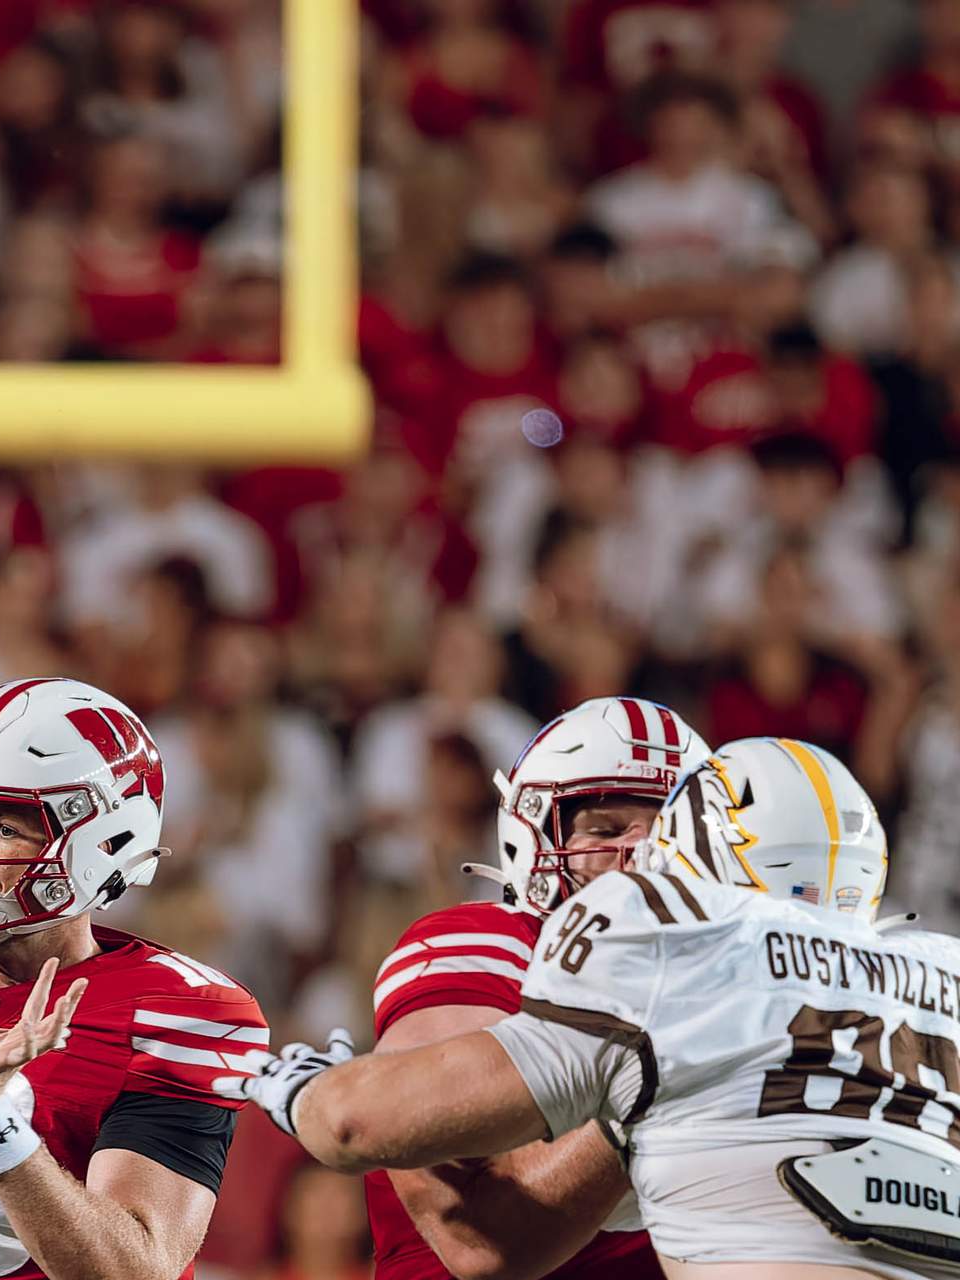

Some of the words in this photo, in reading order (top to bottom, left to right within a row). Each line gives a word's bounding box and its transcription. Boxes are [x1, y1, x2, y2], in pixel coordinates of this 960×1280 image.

[543, 902, 611, 975] 96
[766, 931, 960, 1024] GUSTWILLE
[865, 1176, 960, 1219] DOUGL
